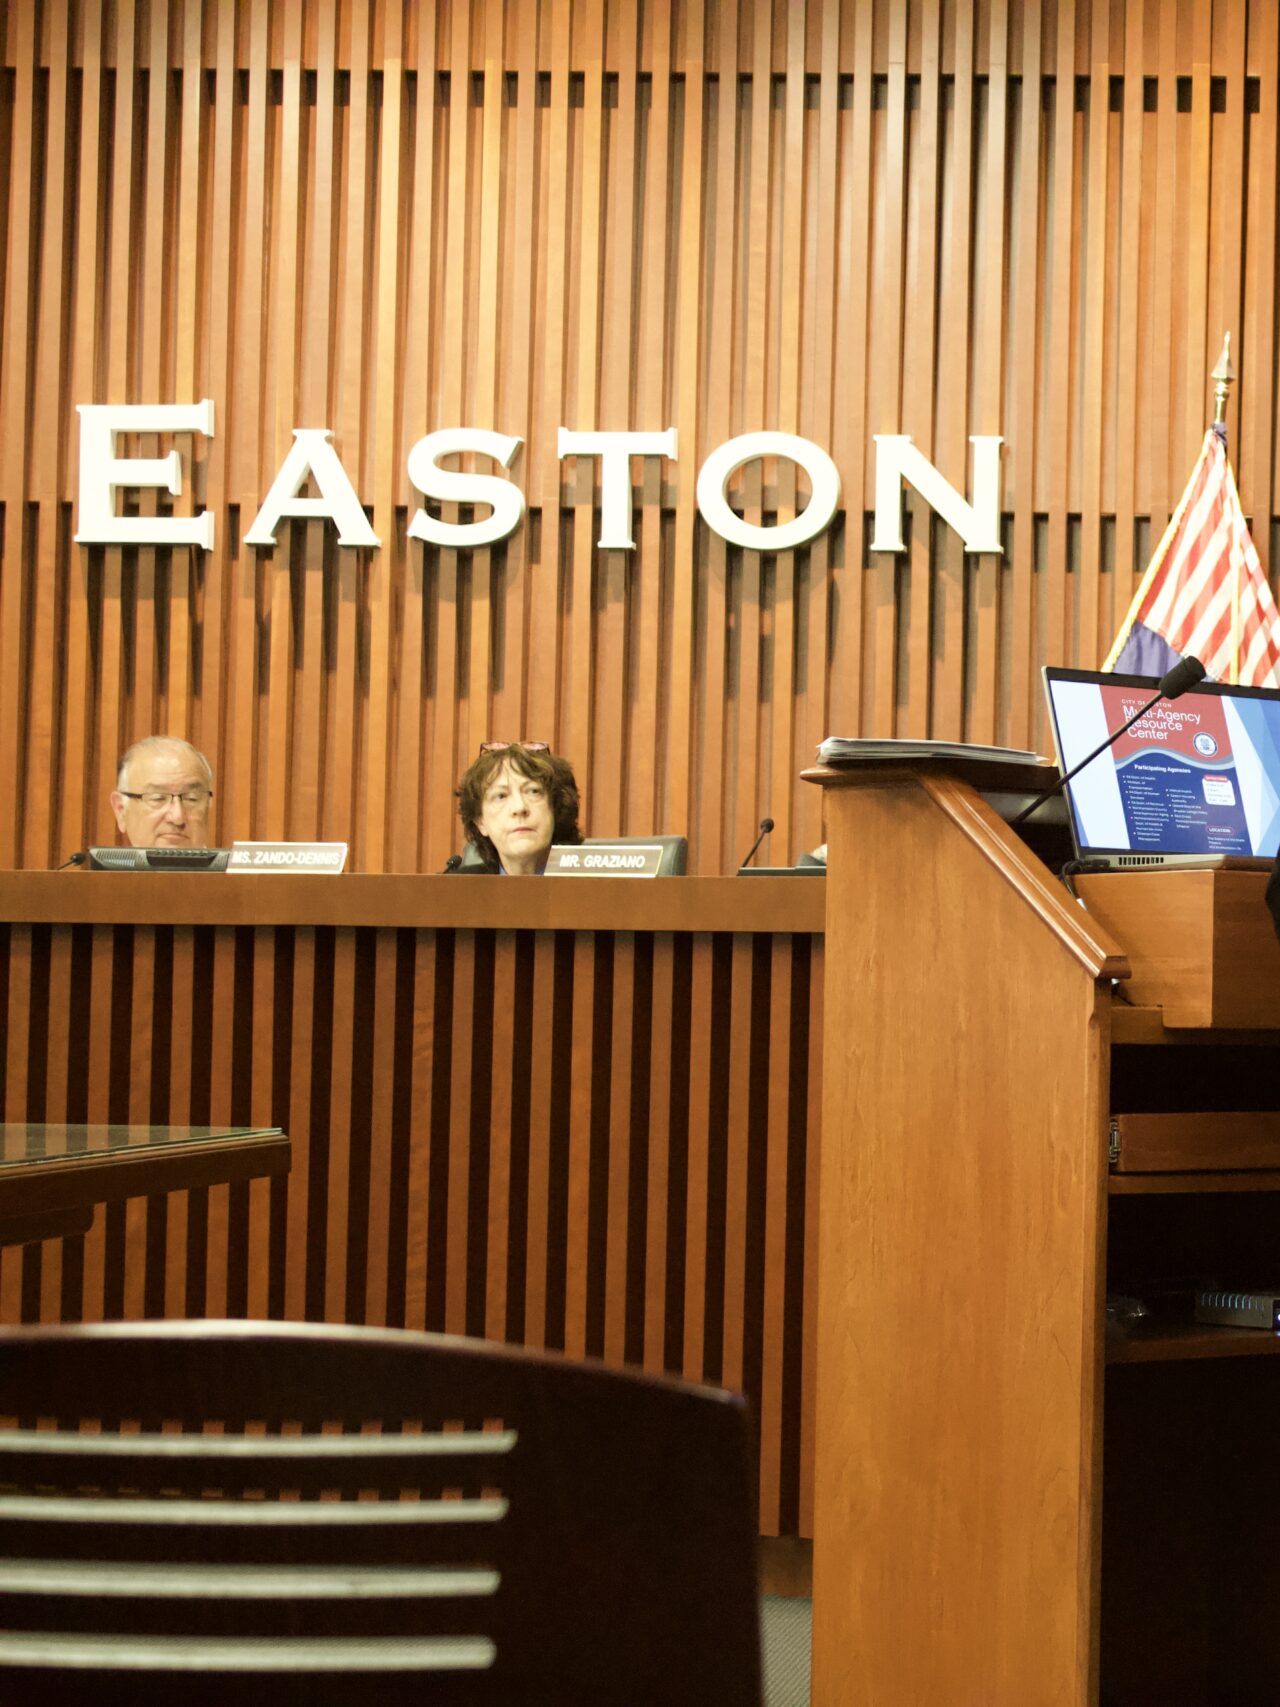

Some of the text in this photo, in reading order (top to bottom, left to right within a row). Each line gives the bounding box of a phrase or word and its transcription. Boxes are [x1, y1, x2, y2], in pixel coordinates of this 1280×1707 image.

[73, 399, 1004, 555] EASTON
[1127, 726, 1168, 740] Center
[232, 851, 339, 864] MS. ZANDO-DENNIS
[560, 854, 646, 868] MR. GRAZIANO
